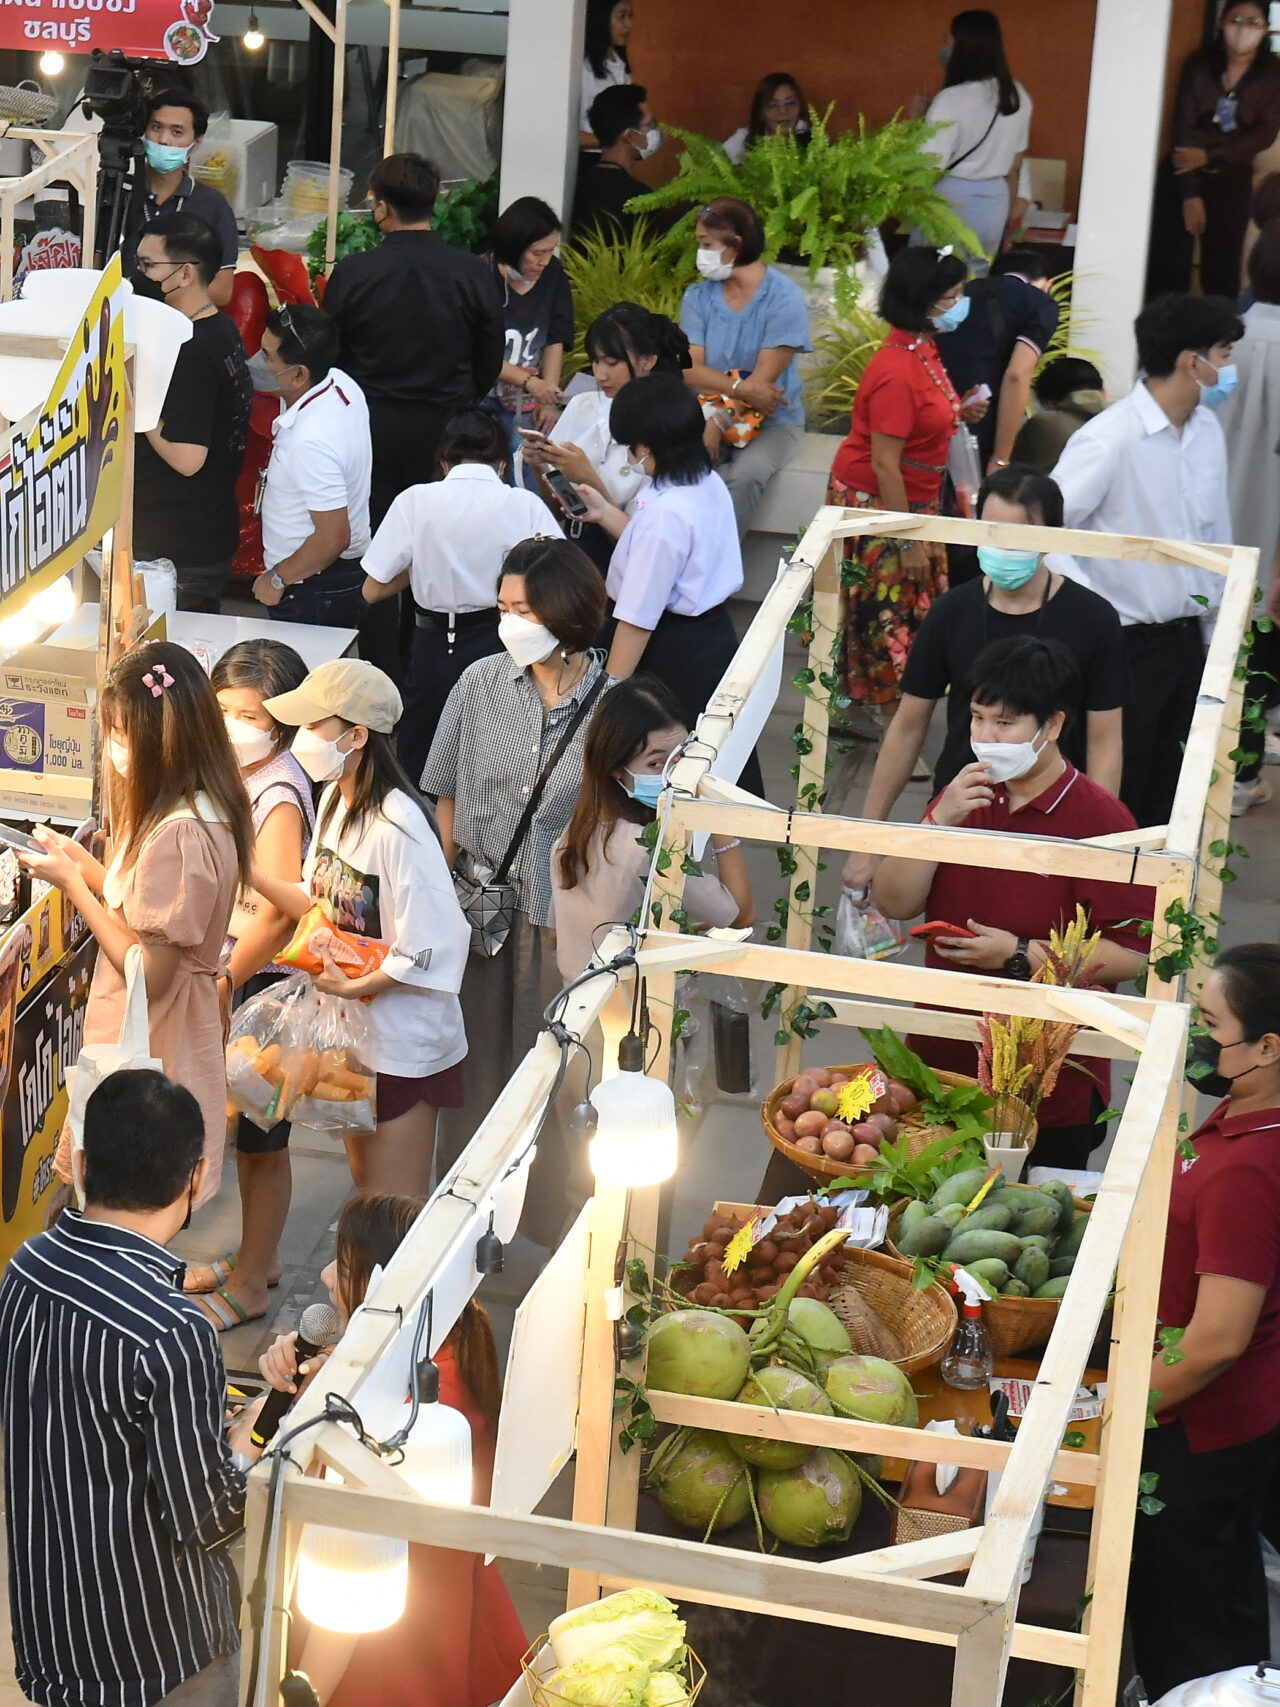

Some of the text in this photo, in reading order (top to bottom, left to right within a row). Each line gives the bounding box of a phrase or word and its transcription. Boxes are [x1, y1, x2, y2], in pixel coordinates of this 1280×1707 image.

[23, 17, 92, 48] ชลบุรี
[25, 684, 69, 697] ระวังแตก
[45, 754, 84, 769] 1,000 มล.
